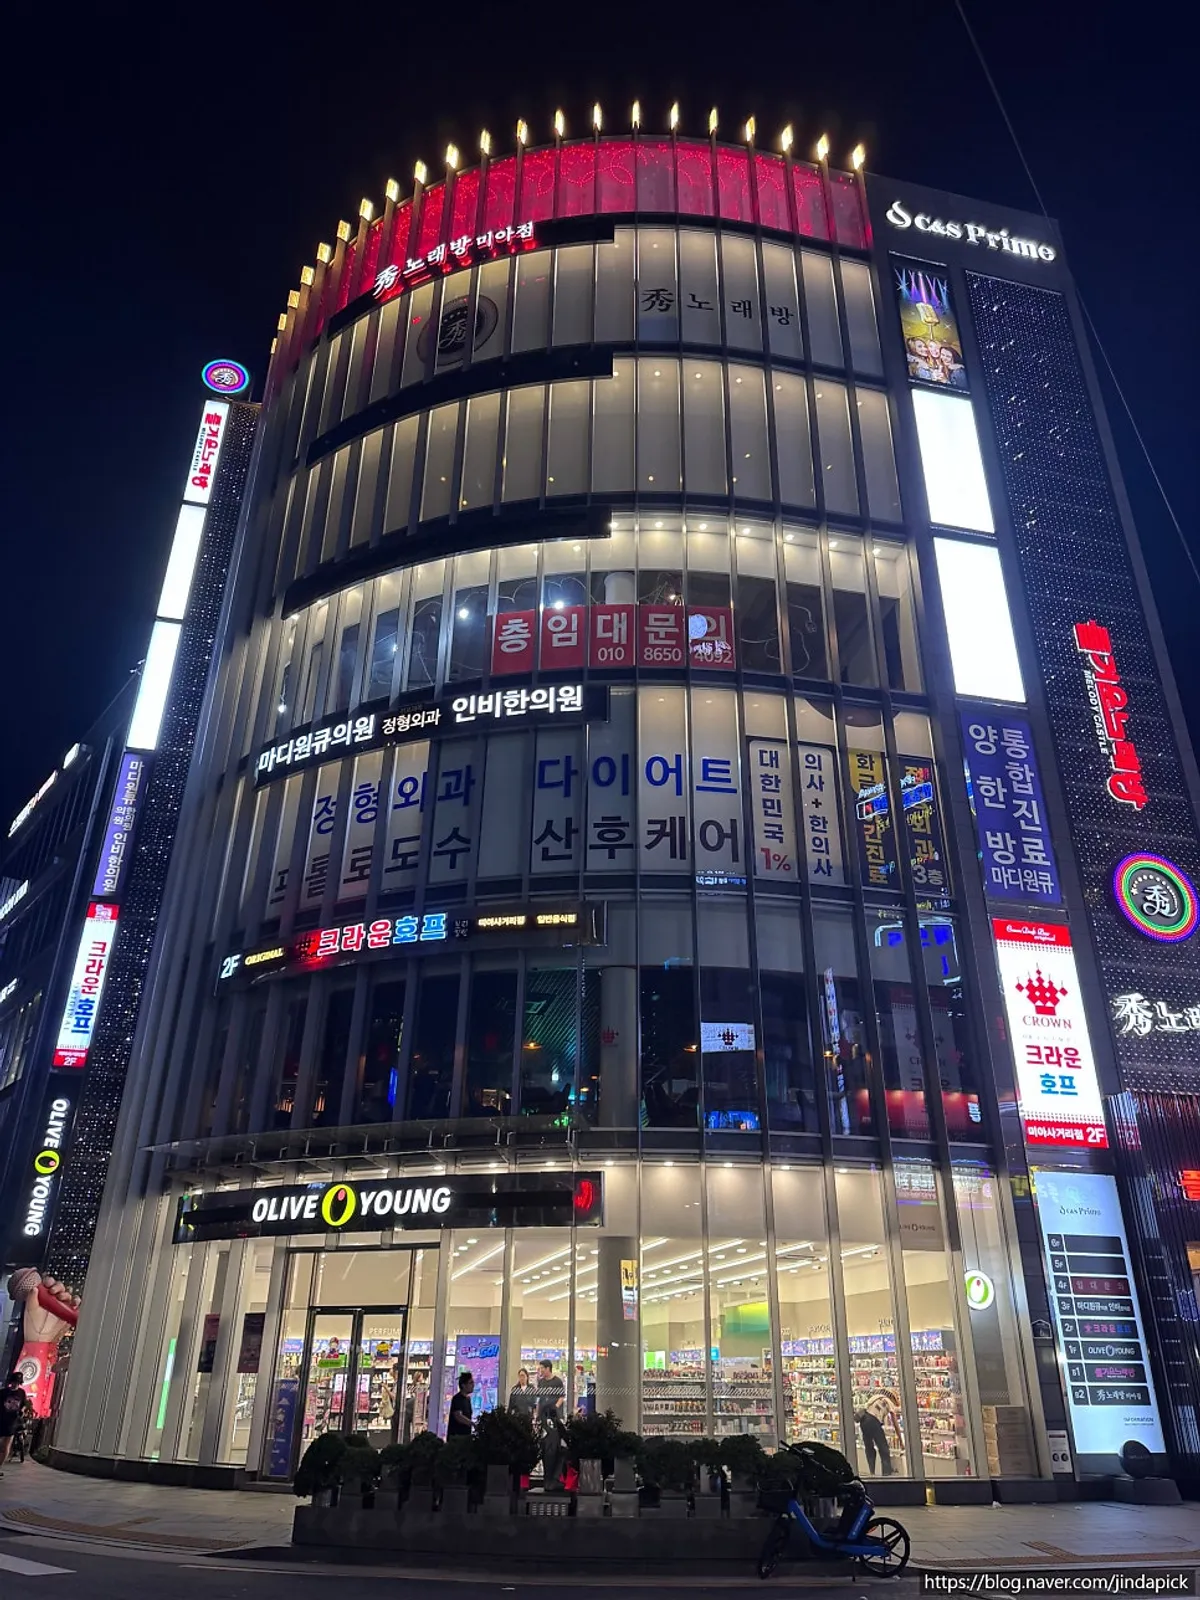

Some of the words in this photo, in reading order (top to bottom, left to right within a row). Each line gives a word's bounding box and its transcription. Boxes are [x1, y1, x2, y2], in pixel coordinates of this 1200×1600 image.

[476, 221, 534, 249] 미아점
[964, 223, 1056, 261] Prime
[598, 648, 625, 662] 010
[644, 648, 682, 663] 8650
[1083, 669, 1099, 713] MELODY
[1092, 714, 1110, 755] CASTLE
[258, 714, 375, 772] 마디원큐의원
[382, 708, 442, 735] 정형외과
[453, 685, 583, 722] 인비한의원
[537, 754, 738, 798] 다이어트
[758, 749, 785, 844] 대한민국
[534, 816, 739, 863] 산후케어
[761, 847, 791, 872] 1%
[992, 866, 1054, 894] 마디원큐
[220, 954, 241, 979] 2F
[244, 948, 285, 966] ORIGINAL
[1022, 1015, 1073, 1030] CROWN
[63, 1056, 77, 1067] 2F
[1025, 1044, 1082, 1069] 크라운
[1039, 1073, 1079, 1096] 호프
[44, 1098, 70, 1149] OLIVE
[1027, 1125, 1085, 1141] 미아사거리점
[1086, 1126, 1106, 1143] 2F
[24, 1176, 52, 1237] YOUNG
[252, 1195, 319, 1223] OLIVE
[360, 1187, 451, 1216] YOUNG
[1054, 1259, 1064, 1269] 5F
[1058, 1280, 1068, 1290] 4F
[1060, 1301, 1071, 1311] 3F
[369, 1327, 402, 1335] PERFUM
[1064, 1322, 1074, 1332] 2F
[1068, 1344, 1077, 1354] 1F
[1074, 1388, 1085, 1399] B2
